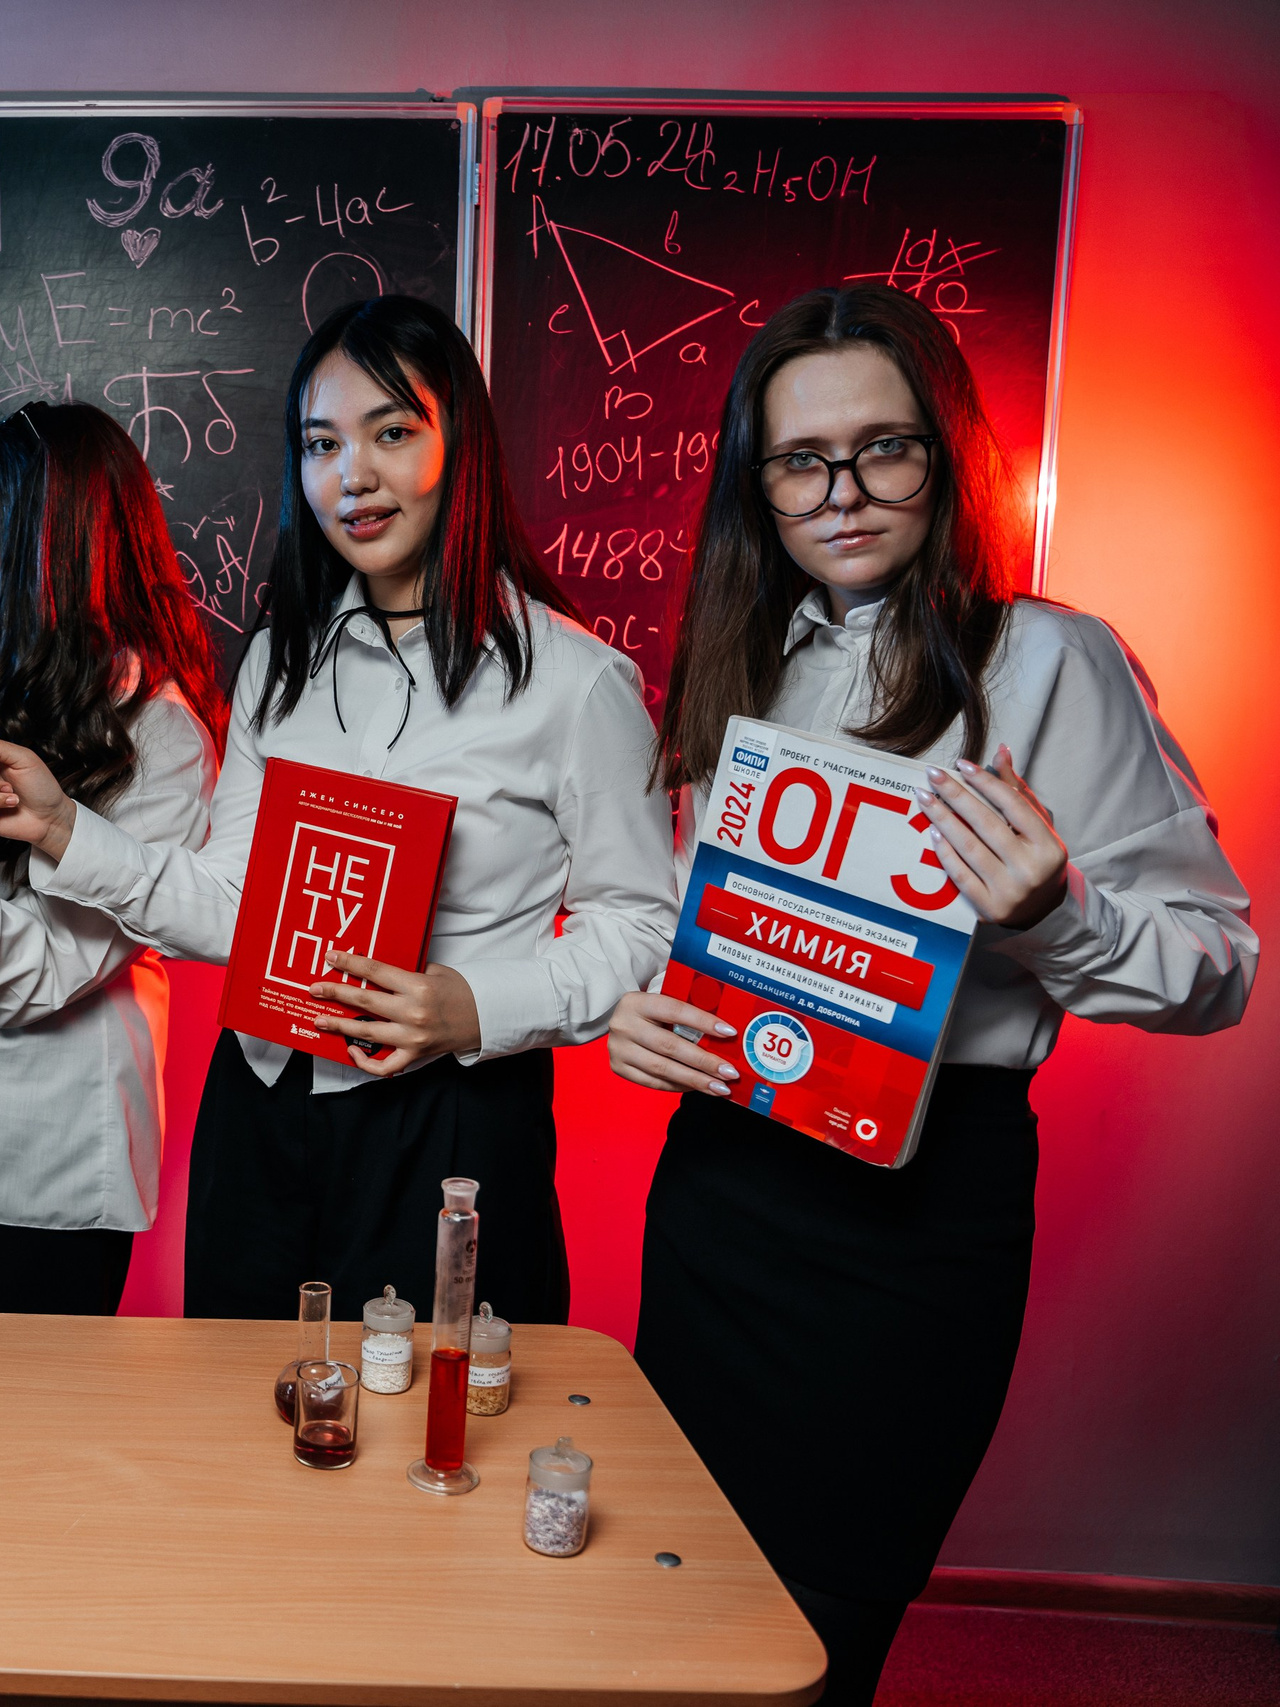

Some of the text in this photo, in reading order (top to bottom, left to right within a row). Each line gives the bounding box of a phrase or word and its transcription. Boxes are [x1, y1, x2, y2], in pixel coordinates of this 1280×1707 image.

[734, 764, 761, 779] ШКОЛЕ
[736, 751, 766, 768] ФИПИ
[780, 748, 811, 763] ПРОЕКТ
[813, 758, 820, 766] С
[823, 760, 867, 780] УЧАСТИЕМ
[300, 790, 404, 820] ДЖЕН СИНСЕРО
[717, 781, 756, 847] 2024
[758, 767, 961, 912] ОГЭ
[305, 846, 370, 898] НЕ
[302, 888, 363, 938] ТУ
[732, 881, 908, 949] ОСНОВНОЙ ГОСУДАРСТВЕННЫЙ ЭКЗАМЕН
[745, 911, 872, 979] ХИМИЯ
[718, 943, 883, 1013] ТИПОВЫЕ ЭКЗАМЕНАЦИОННЫЕ ВАРИАНТЫ
[728, 970, 745, 982] ПОД
[747, 977, 796, 1002] РЕДАКЦИЕЙ
[817, 1006, 860, 1027] ДОБРОТИНА
[762, 1052, 787, 1065] ВАРИАНТОВ
[763, 1031, 792, 1058] 30
